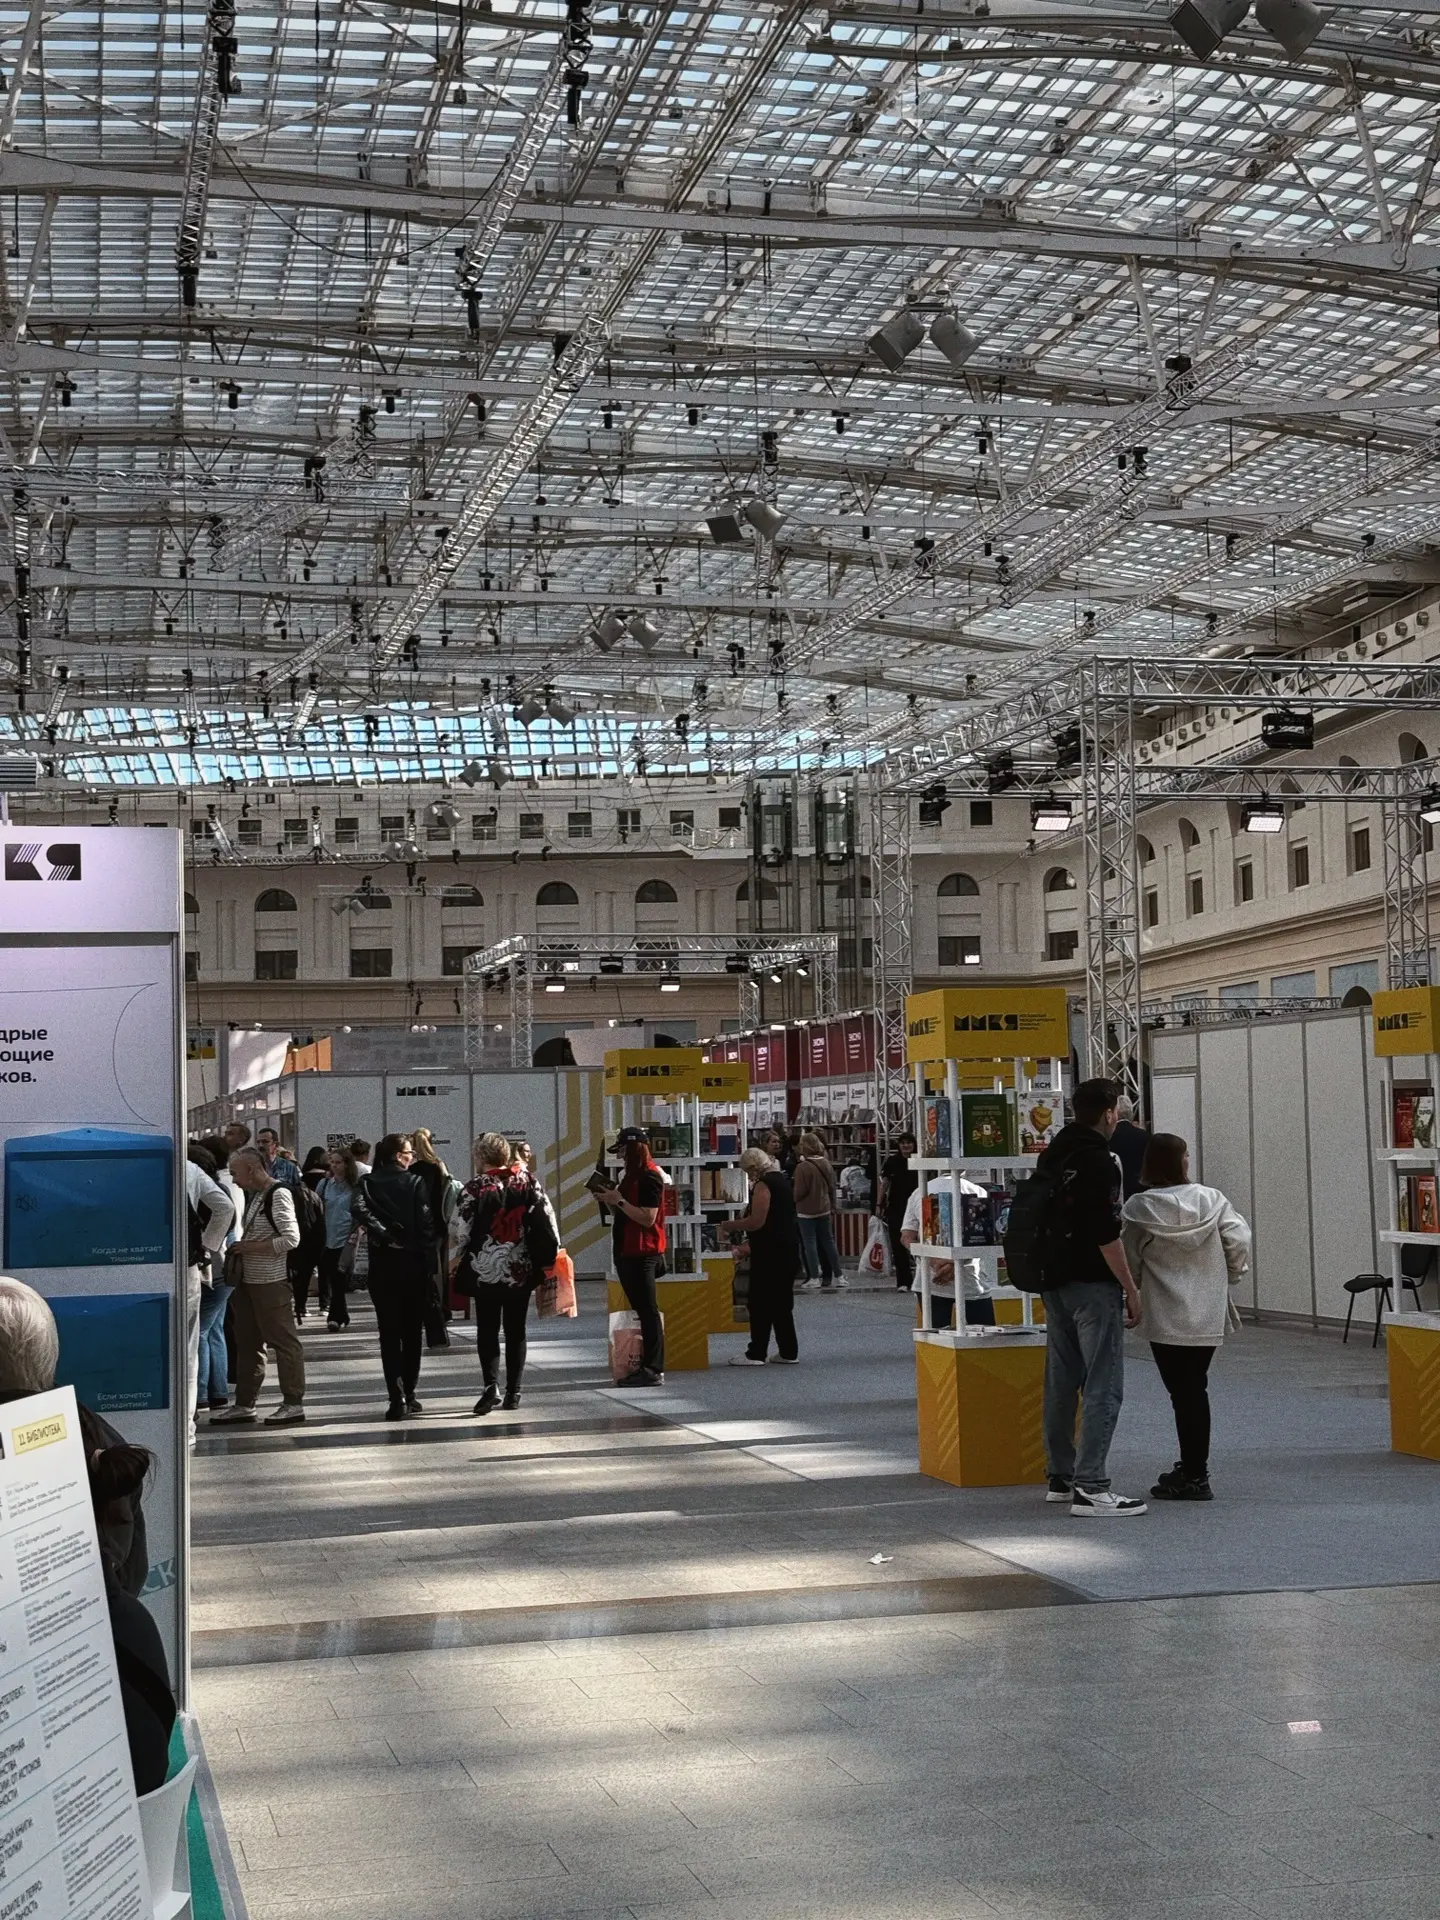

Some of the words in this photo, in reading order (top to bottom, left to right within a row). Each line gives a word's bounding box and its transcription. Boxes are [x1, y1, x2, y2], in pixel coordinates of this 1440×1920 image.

[954, 1014, 1018, 1031] ММКЯ
[627, 1065, 670, 1077] ММКЯ
[0, 1071, 37, 1083] ков.
[396, 1086, 437, 1096] ММКЯ
[91, 1246, 116, 1255] Когда
[130, 1245, 163, 1253] хватает
[97, 1392, 117, 1401] Если
[119, 1391, 152, 1400] хочется
[100, 1401, 148, 1410] романтики
